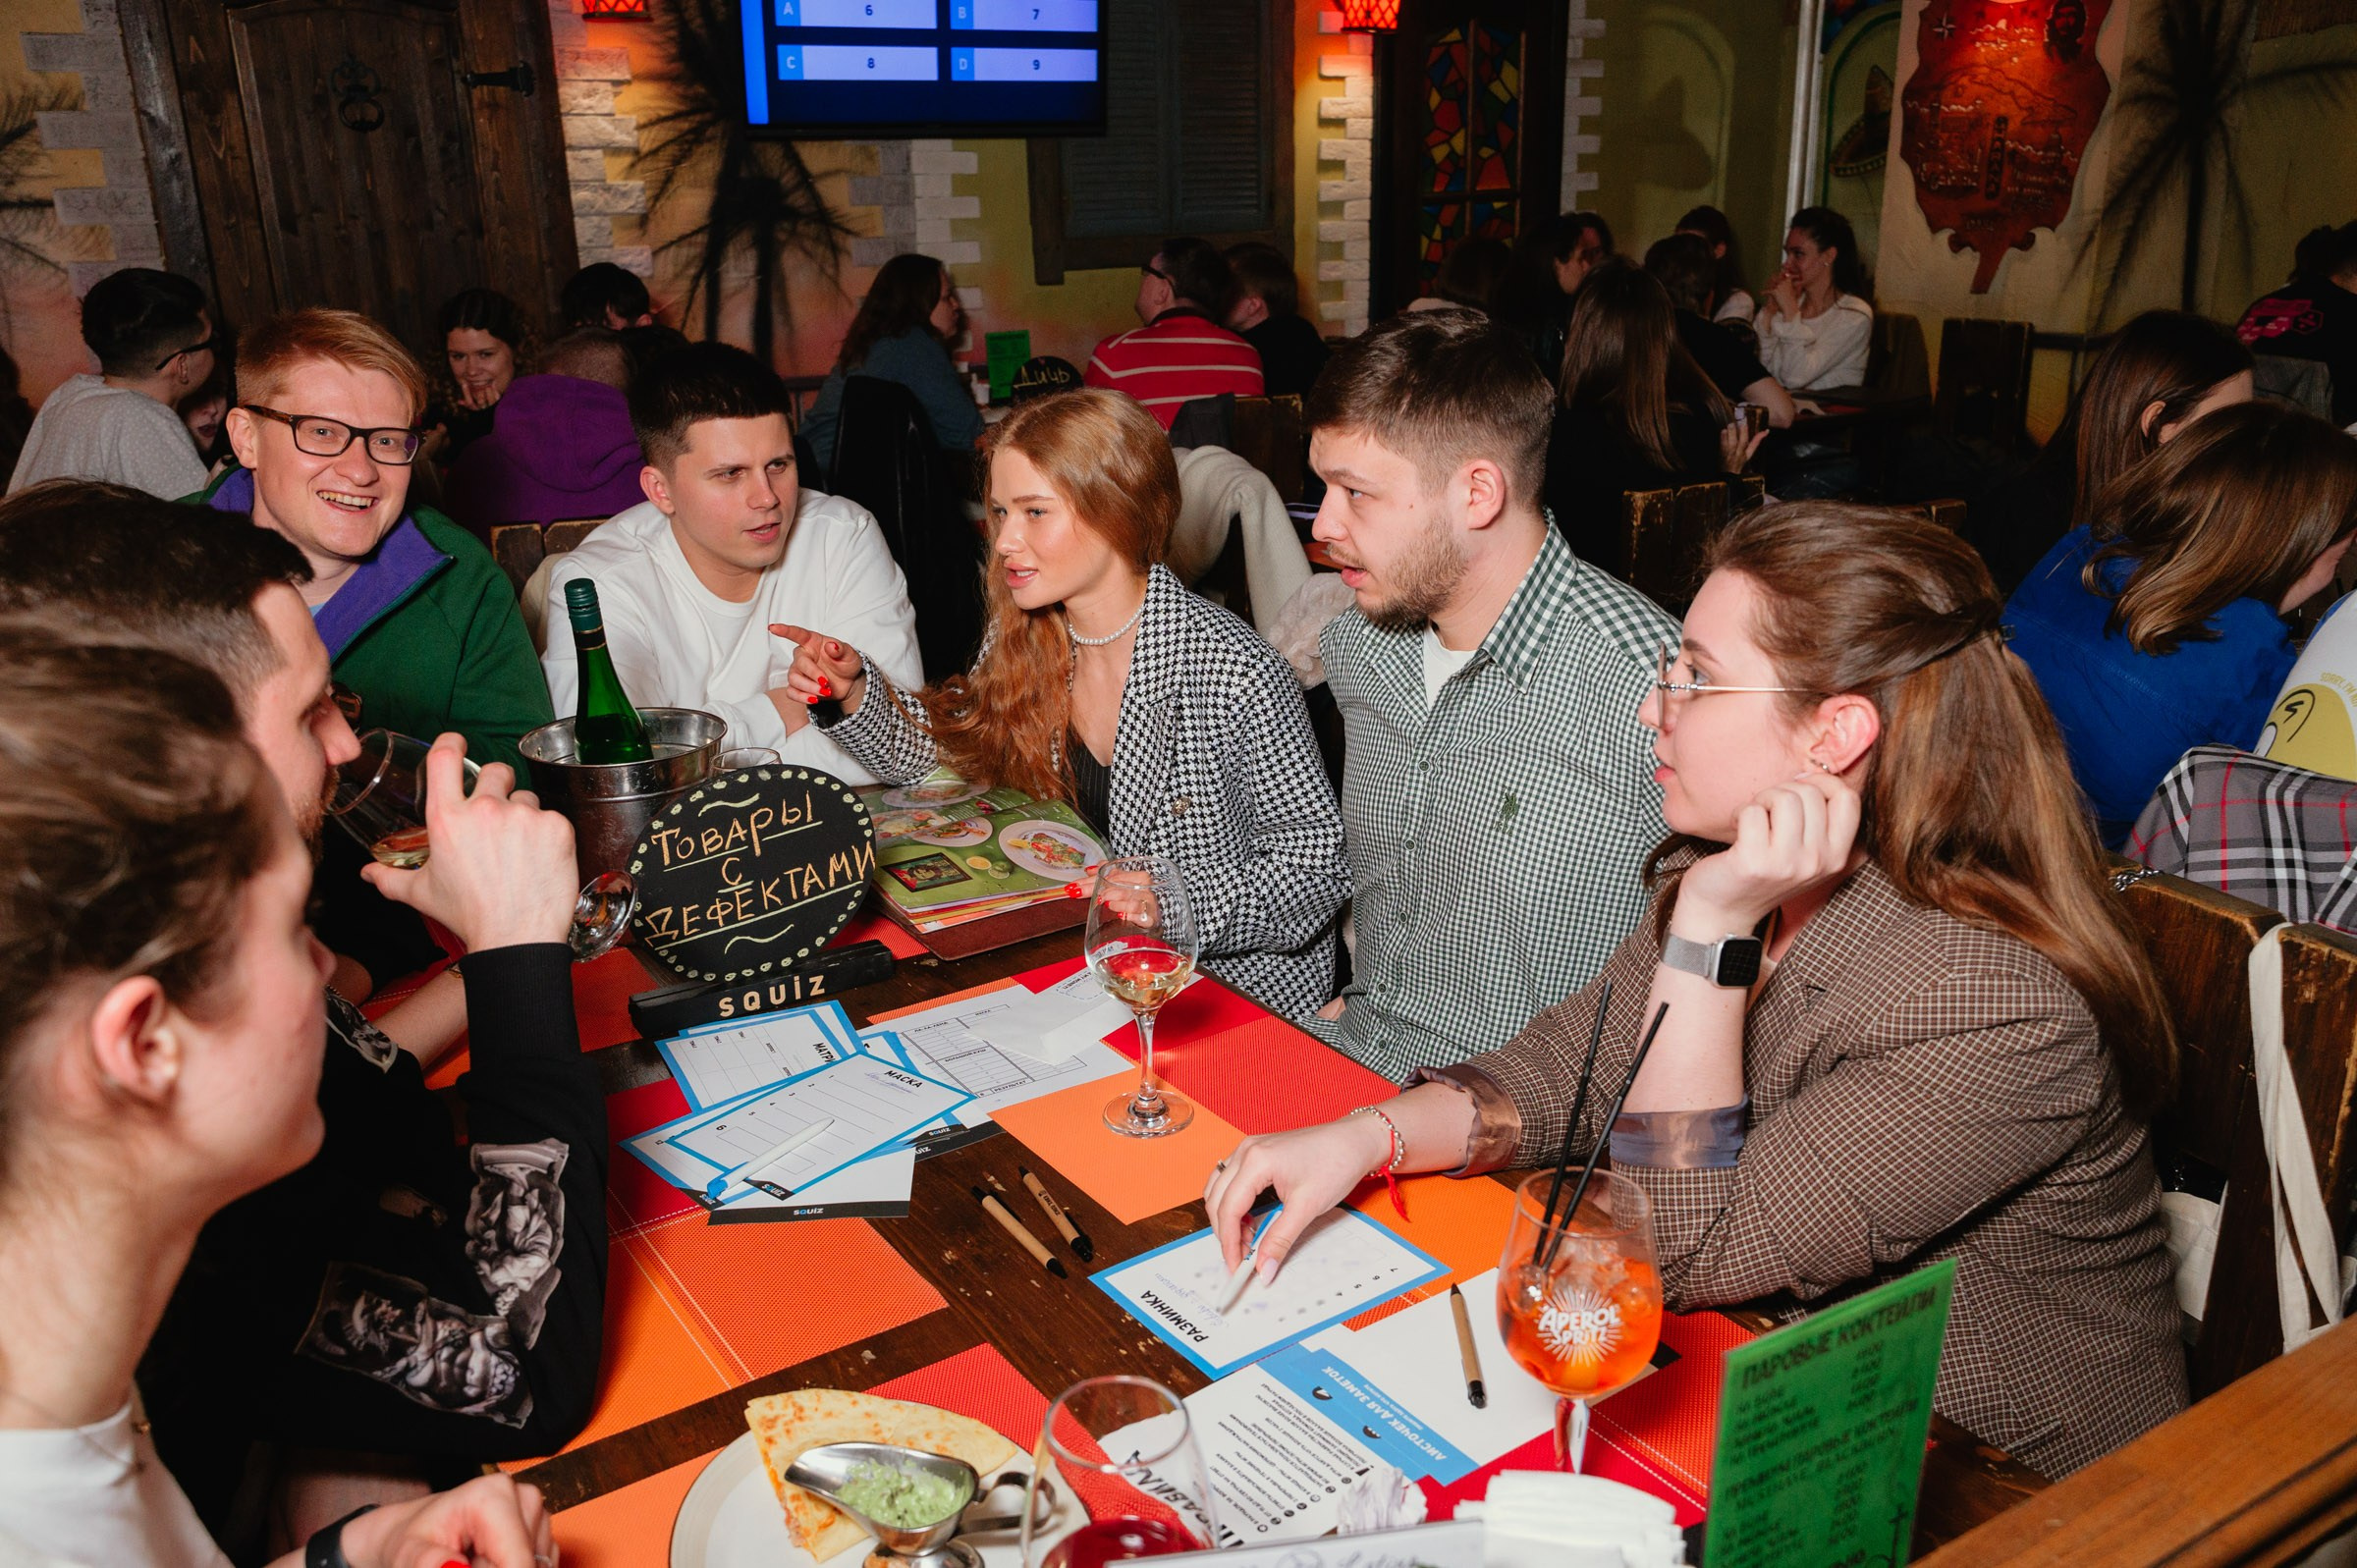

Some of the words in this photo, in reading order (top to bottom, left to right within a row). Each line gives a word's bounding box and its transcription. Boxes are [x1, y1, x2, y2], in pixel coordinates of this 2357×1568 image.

[783, 2, 795, 16] A
[865, 4, 873, 16] 6
[958, 7, 966, 19] B
[1032, 9, 1040, 21] 7
[787, 56, 795, 69] C
[867, 57, 875, 69] 8
[959, 58, 967, 70] D
[1032, 59, 1040, 71] 9
[651, 789, 814, 866] ТОВАРЫ
[722, 857, 740, 886] С
[644, 840, 876, 947] ДЕФЕКТАМИ
[719, 975, 825, 1017] SQUIZ
[885, 1070, 923, 1088] МАСКА
[928, 1126, 951, 1137] SQUIZ
[761, 1183, 786, 1197] SQUIZ
[794, 1207, 824, 1216] SQUIZ
[1140, 1290, 1209, 1343] РАЗМИНКА
[1538, 1305, 1620, 1331] APEROL
[1551, 1326, 1609, 1346] SPRITZ
[1742, 1327, 1834, 1389] ПАРОВЫЕ
[1321, 1365, 1372, 1403] ЗАМЕТОК
[1365, 1397, 1395, 1423] ДЛЯ
[1386, 1415, 1447, 1463] ЛИСТОЧЕК
